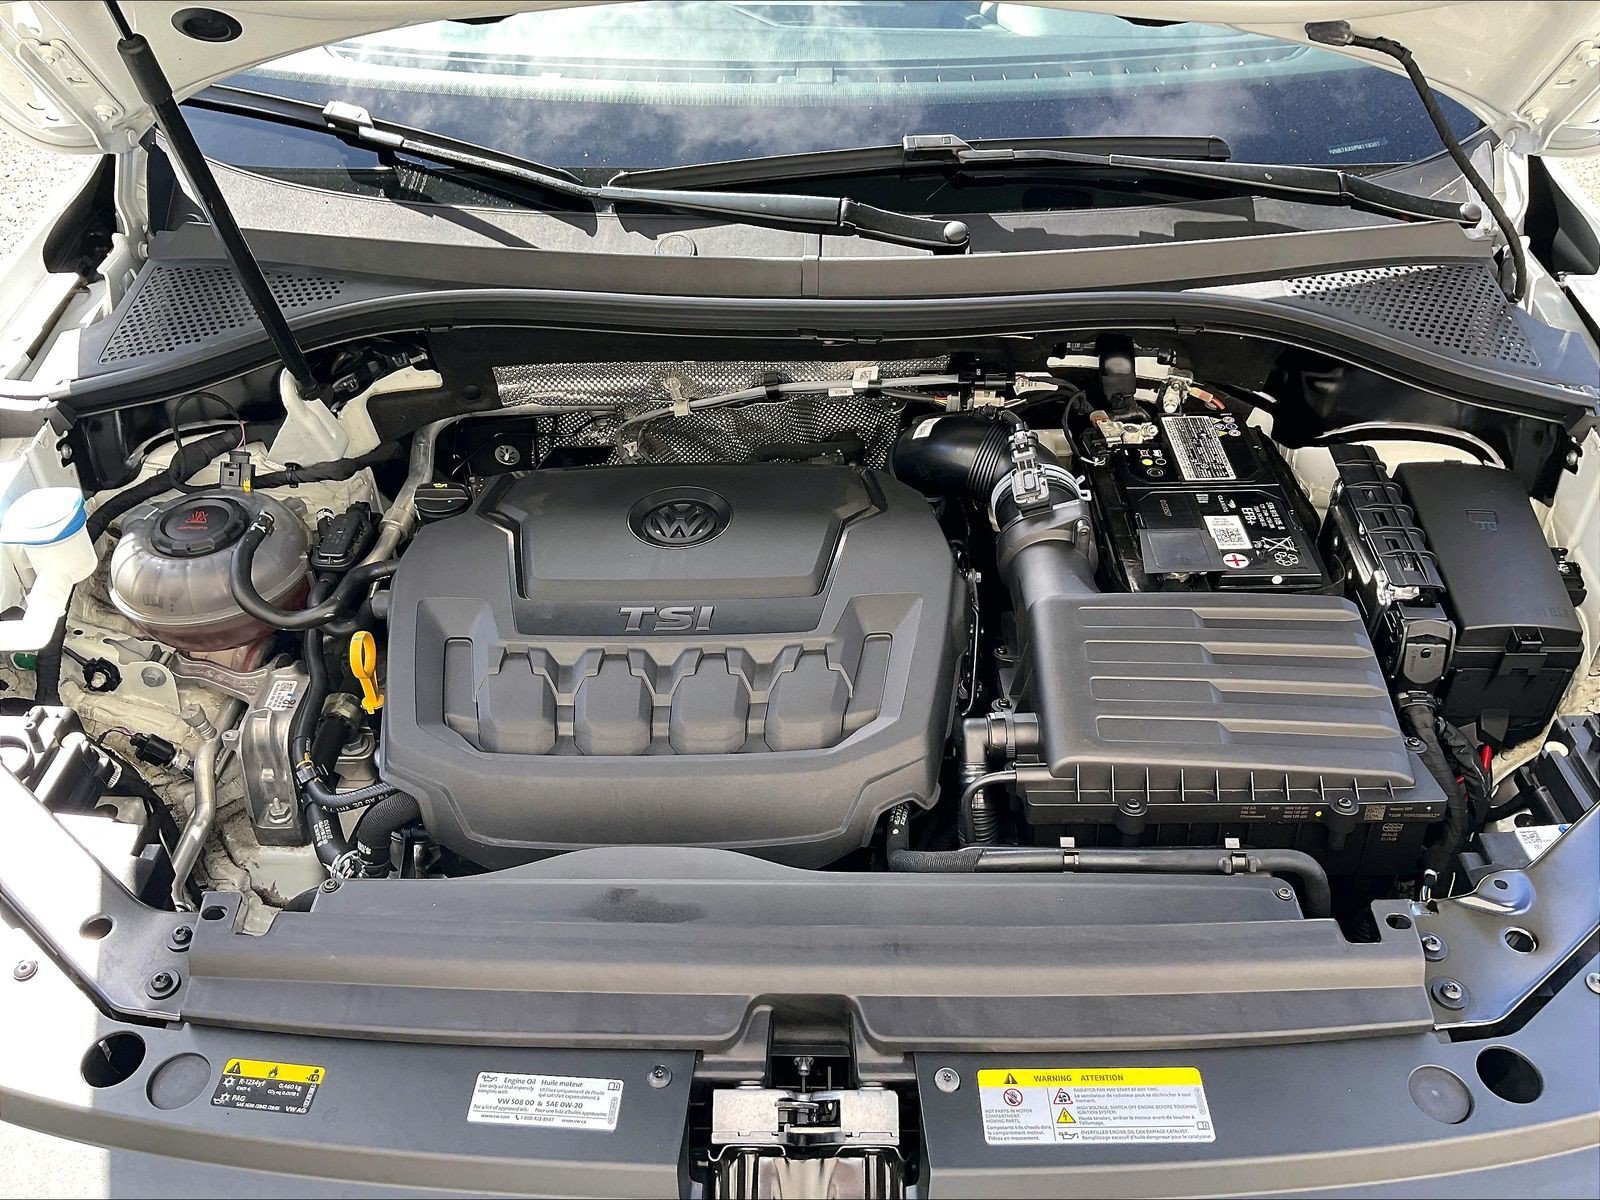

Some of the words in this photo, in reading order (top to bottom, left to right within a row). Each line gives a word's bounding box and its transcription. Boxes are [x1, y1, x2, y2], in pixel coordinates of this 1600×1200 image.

[1218, 495, 1229, 512] CLARIOS
[645, 499, 717, 545] VW
[1241, 507, 1256, 526] EFB+
[618, 604, 716, 632] TSI
[239, 1078, 266, 1087] R-1234yf
